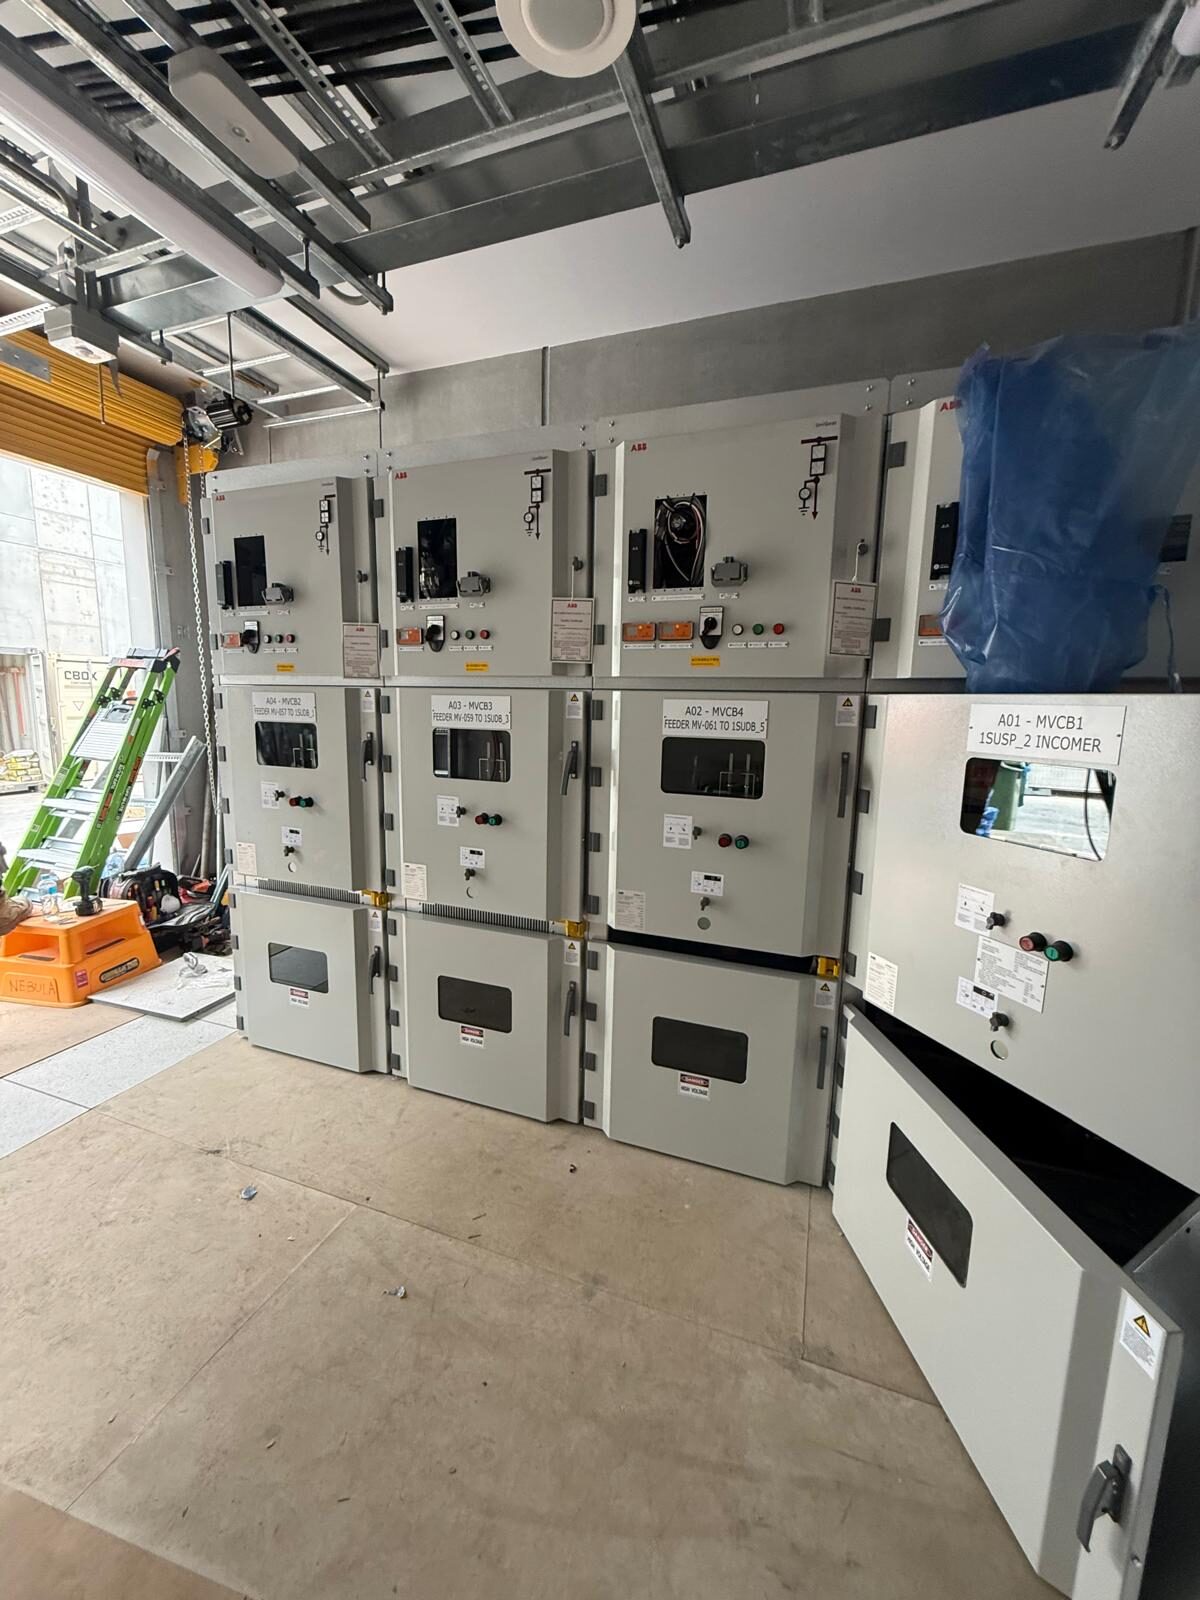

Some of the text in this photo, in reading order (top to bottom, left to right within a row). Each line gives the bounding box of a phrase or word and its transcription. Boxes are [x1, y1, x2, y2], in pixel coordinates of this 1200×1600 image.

[448, 701, 462, 710] A03
[468, 701, 493, 710] MVCB3
[685, 706, 702, 716] A02
[712, 707, 744, 717] MVCB4
[432, 712, 453, 722] FEEDER
[454, 713, 474, 722] MV-059
[475, 714, 483, 722] TO
[998, 713, 1021, 727] A01
[1036, 715, 1083, 730] MVCB1
[664, 719, 765, 734] FEEDER MV-061 TO 1SUDB_5
[979, 732, 1101, 752] 1SUSP_2 INCOMER
[9, 979, 56, 995] NEBULA
